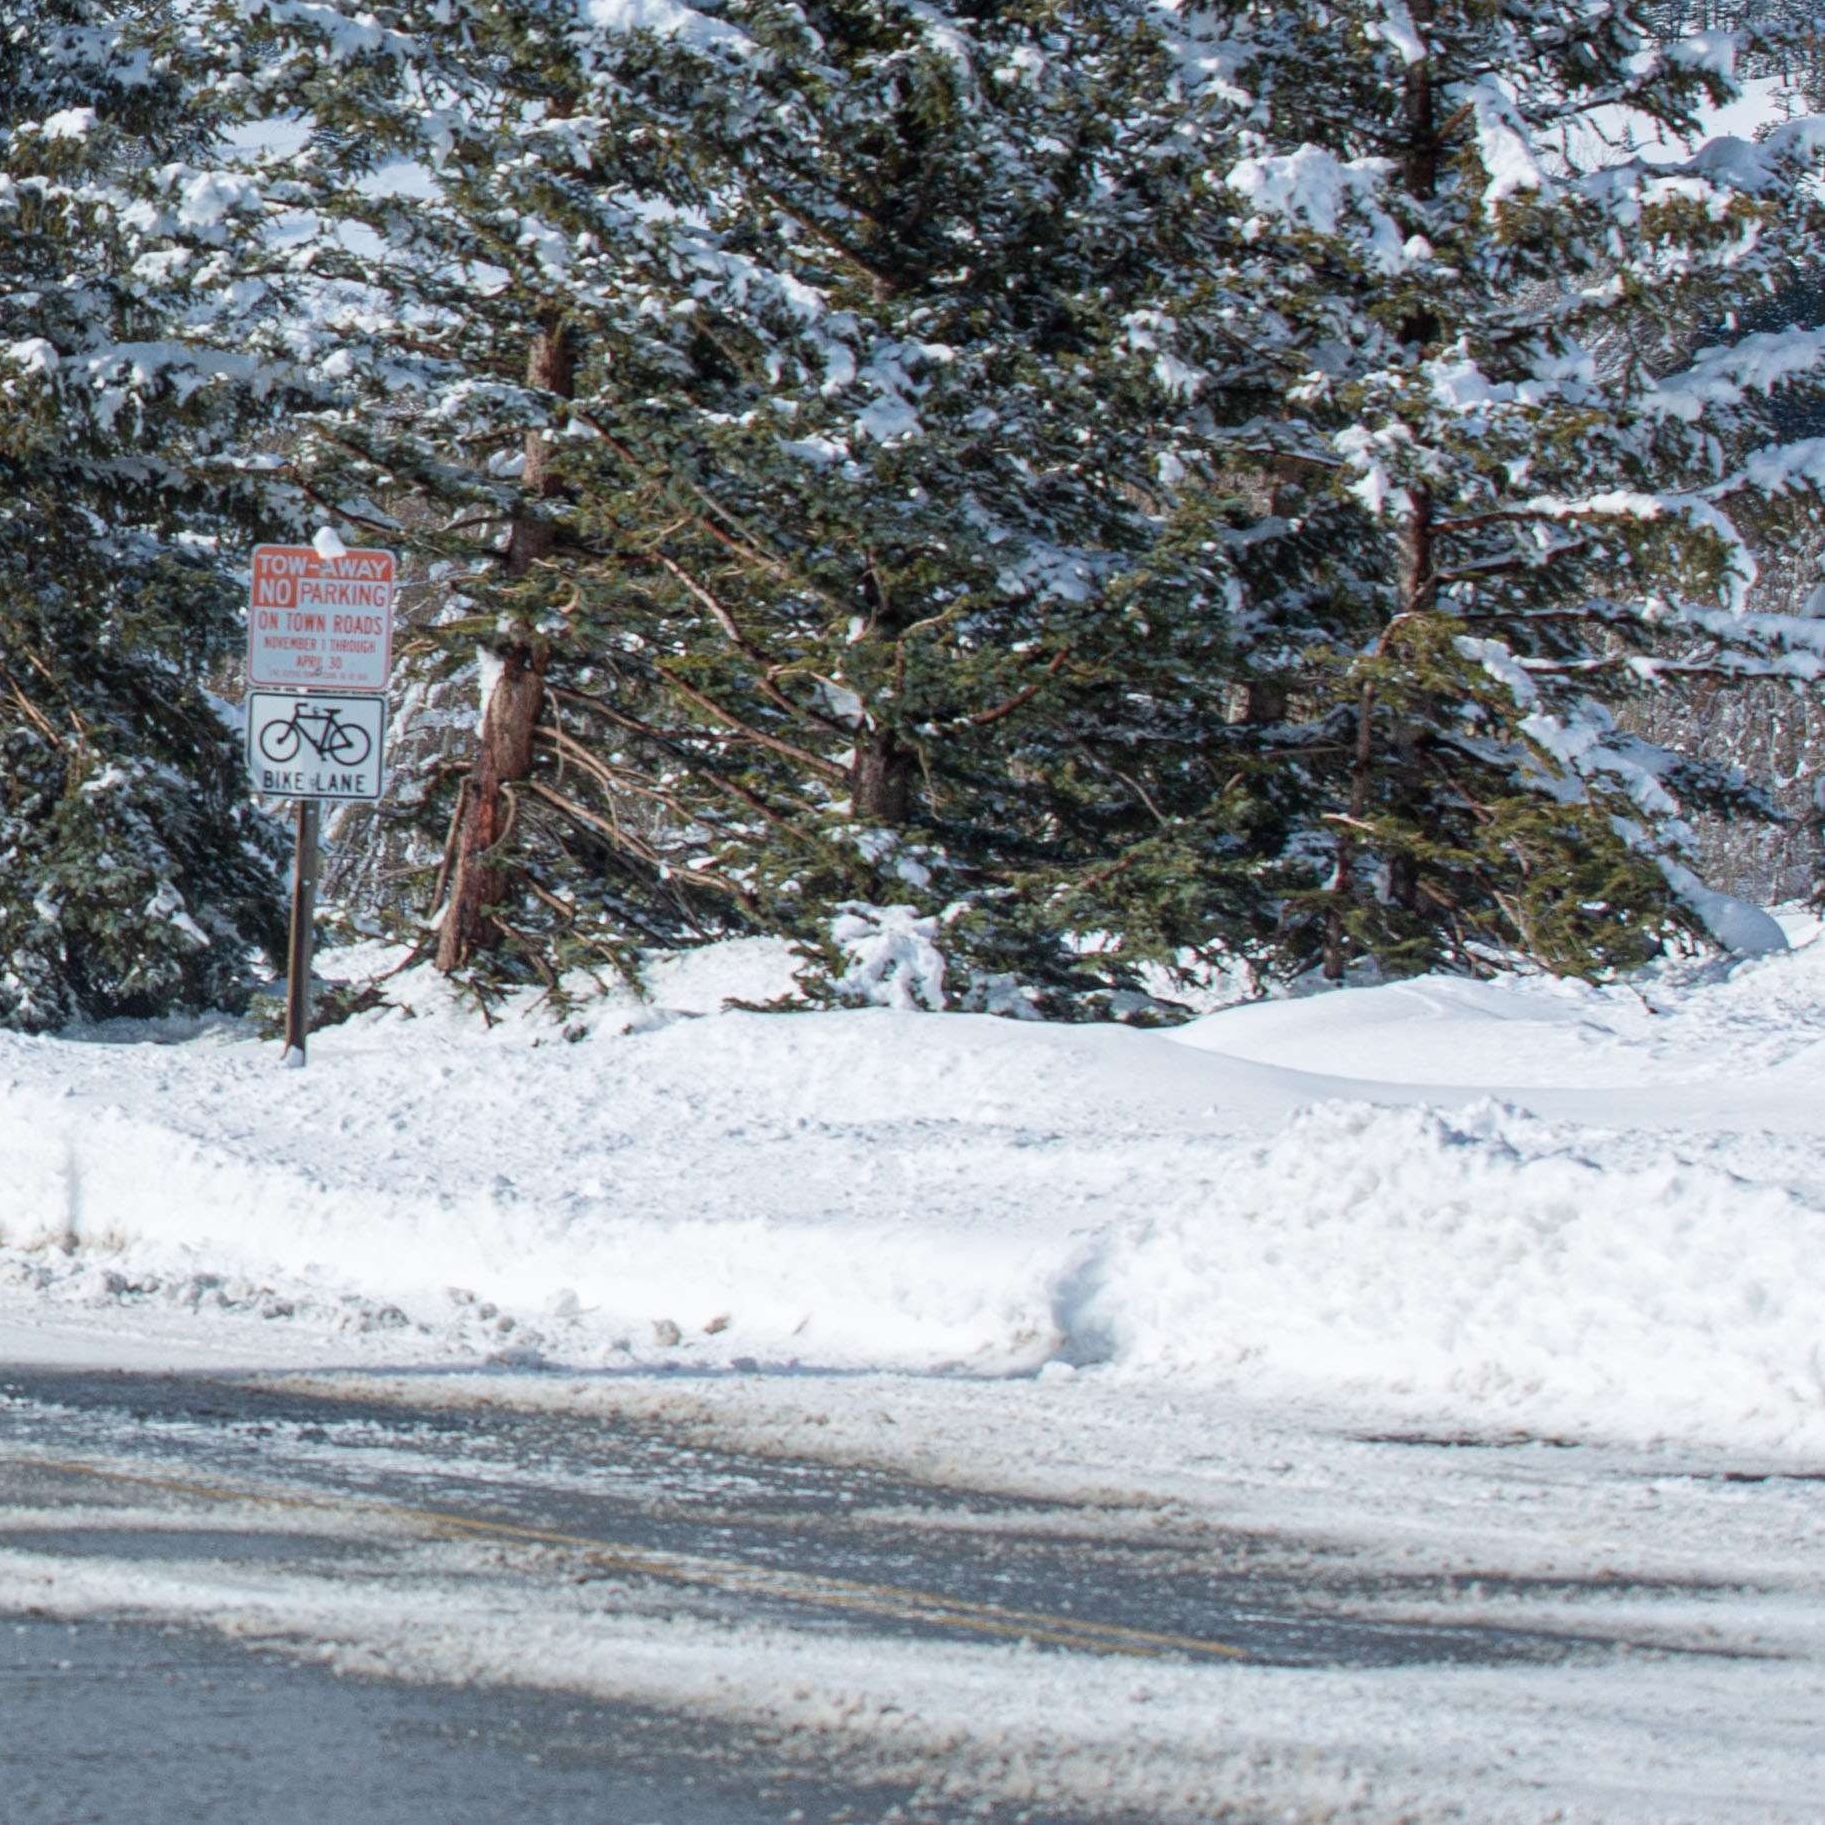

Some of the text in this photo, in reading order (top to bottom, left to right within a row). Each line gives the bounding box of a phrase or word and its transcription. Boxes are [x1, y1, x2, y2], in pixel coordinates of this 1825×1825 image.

[258, 555, 388, 578] TOW-AWAY
[259, 578, 386, 607] NO PARKING
[258, 610, 383, 636] ON TOWN ROADS
[264, 637, 316, 650] NOVEMBER
[330, 638, 375, 653] THROUGH
[263, 770, 365, 793] BIKE LANE
